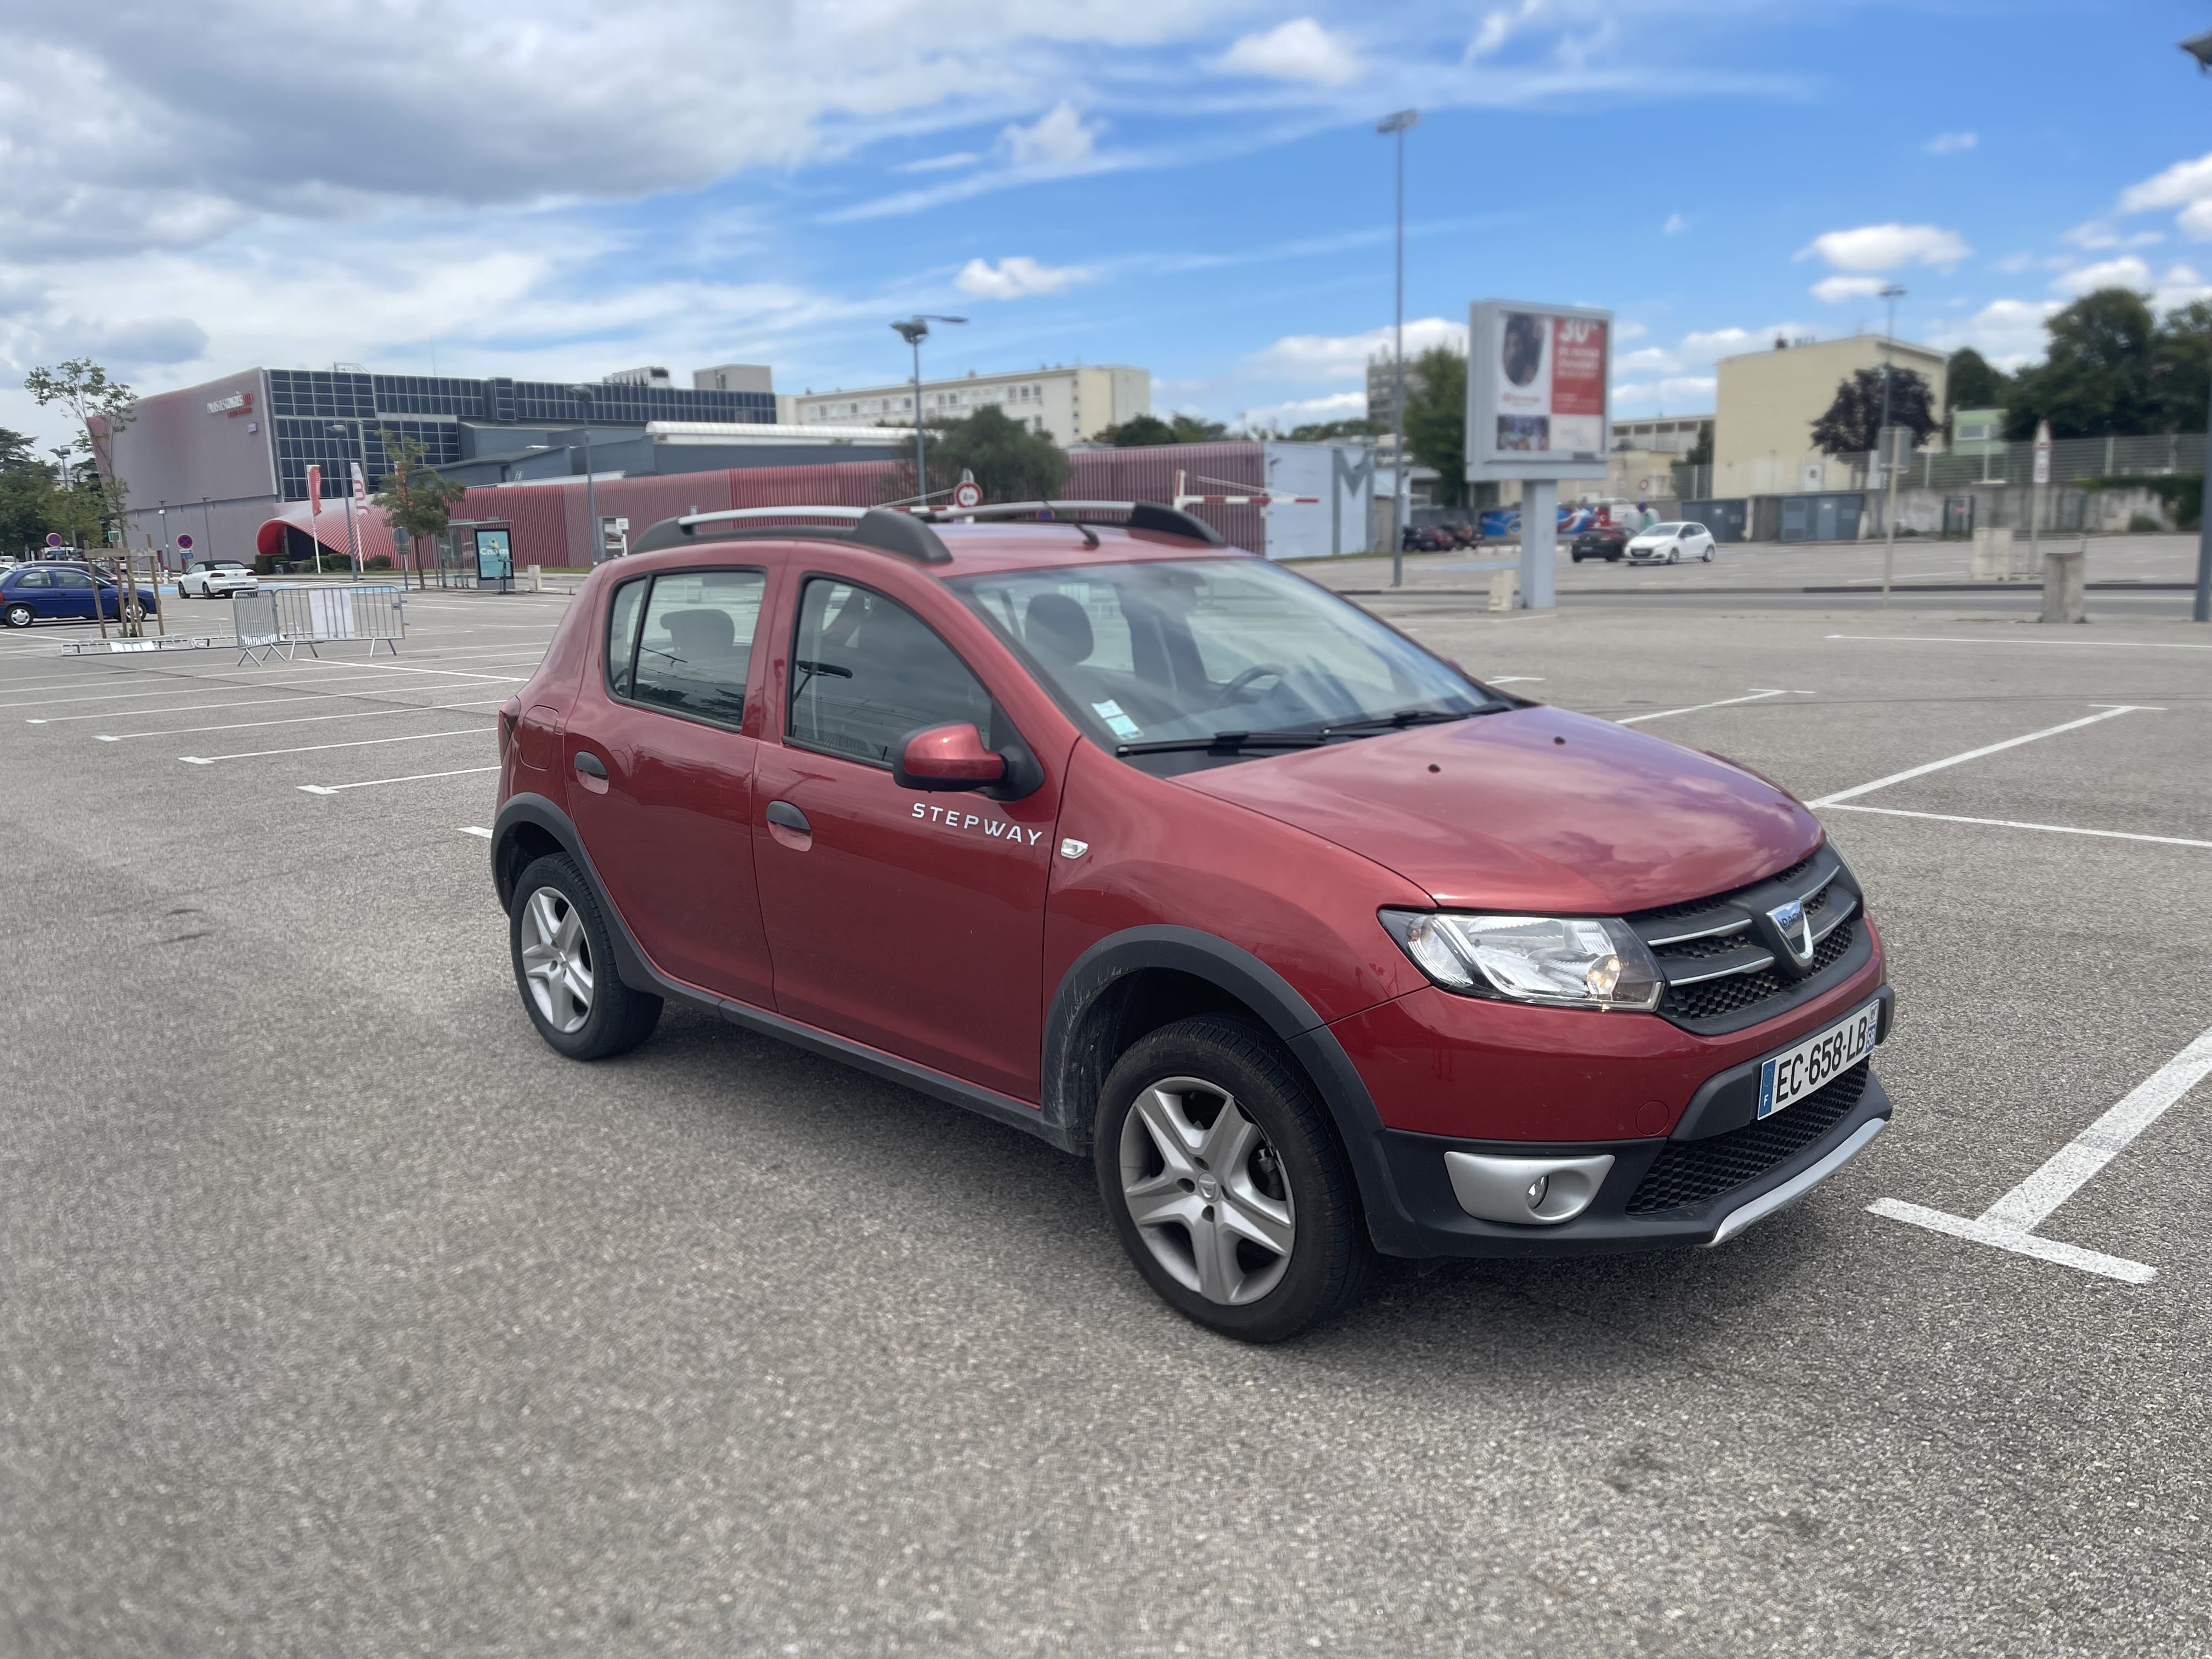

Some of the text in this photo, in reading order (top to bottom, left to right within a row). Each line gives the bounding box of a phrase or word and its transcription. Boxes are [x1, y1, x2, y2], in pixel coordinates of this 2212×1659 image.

[912, 803, 1043, 845] STEPWAY
[1866, 1028, 1875, 1048] 58
[1776, 1016, 1867, 1104] EC-658-LB
[1763, 1094, 1769, 1107] F
